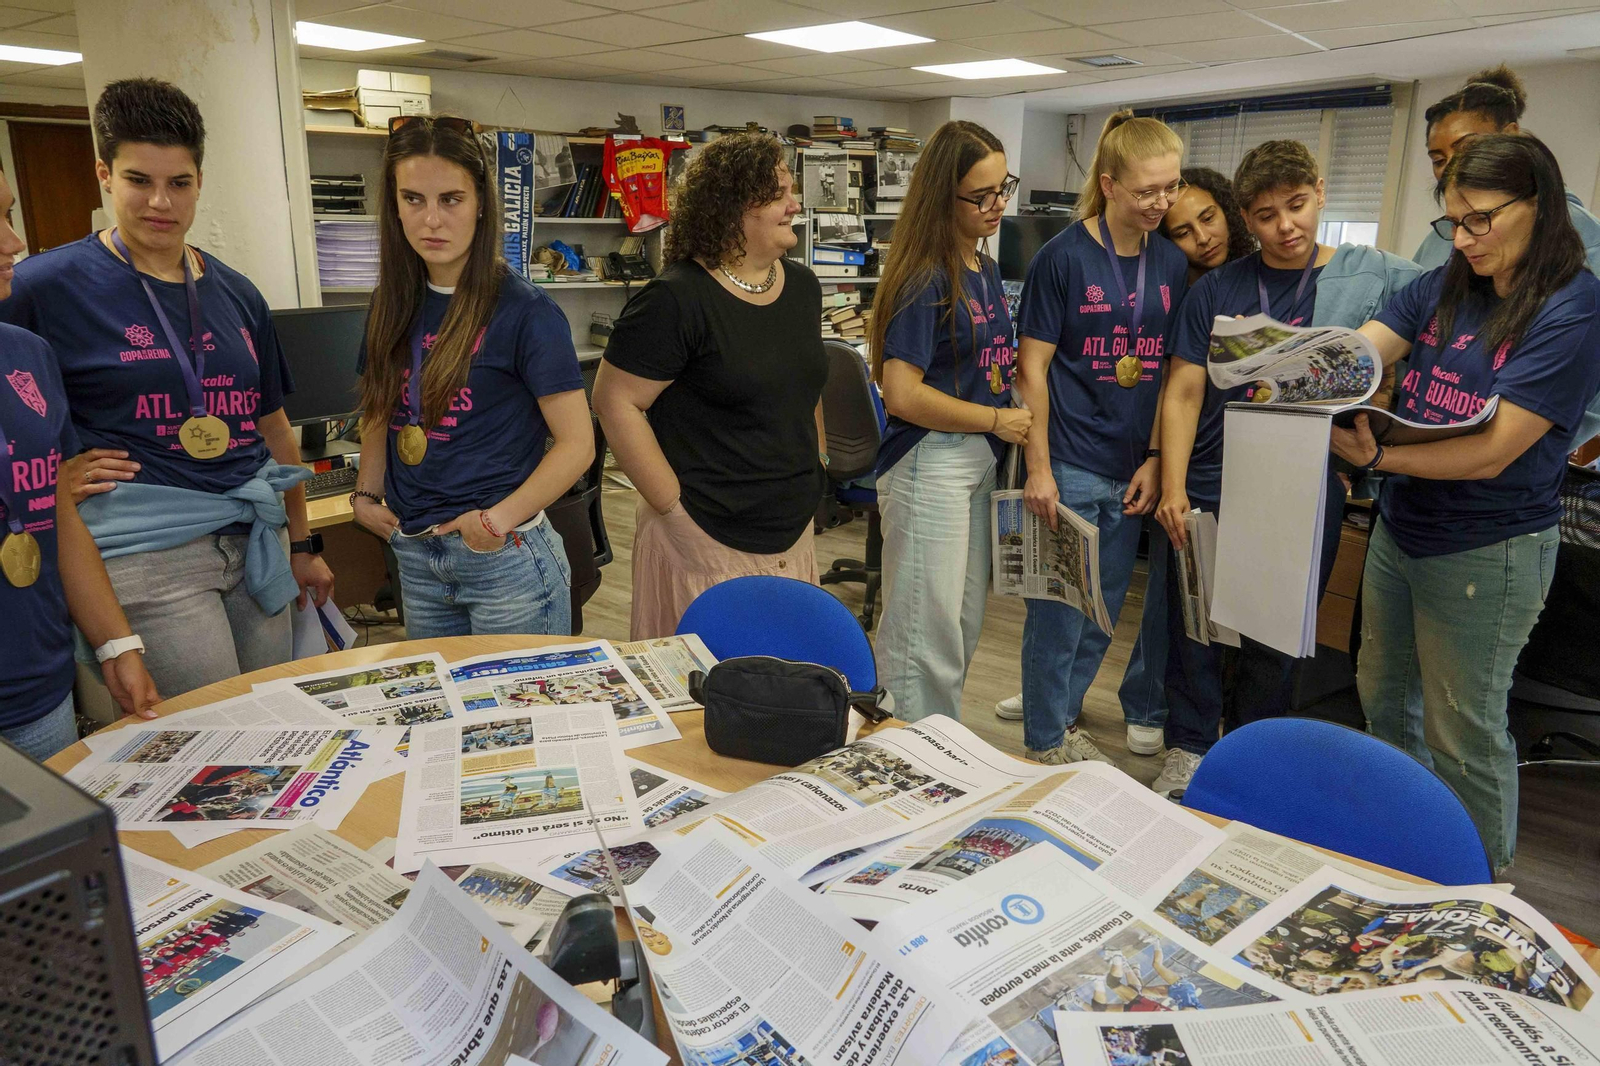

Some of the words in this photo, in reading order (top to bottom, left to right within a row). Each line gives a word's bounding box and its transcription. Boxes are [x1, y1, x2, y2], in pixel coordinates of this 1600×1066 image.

[1079, 305, 1093, 314] COPA
[1097, 304, 1112, 313] REINA
[120, 351, 142, 362] COPA
[148, 348, 171, 359] REINA
[1082, 337, 1110, 356] ATL.
[1112, 334, 1164, 356] GURDÉ
[135, 393, 183, 419] ATL.
[1425, 380, 1487, 418] GUARDÉS
[618, 720, 656, 735] Atlántic
[921, 732, 946, 752] paso
[299, 738, 371, 808] Atlántico
[652, 789, 681, 808] Guardés
[800, 777, 848, 812] cañonazos
[526, 825, 539, 834] el
[541, 822, 570, 833] será
[572, 820, 583, 830] si
[1209, 861, 1223, 871] su
[1228, 861, 1272, 886] europeo
[743, 871, 760, 887] curso
[748, 876, 766, 893] Lloria
[898, 882, 938, 896] porte
[1224, 868, 1277, 896] conquista
[177, 892, 214, 914] Nada
[719, 884, 747, 911] lesionado
[729, 889, 752, 911] regresa
[135, 910, 176, 937] person
[703, 916, 714, 927] 42
[708, 911, 729, 932] Novás
[710, 907, 722, 919] con
[1118, 909, 1133, 924] El
[690, 923, 706, 938] años
[698, 928, 712, 941] tras
[908, 933, 929, 948] 886
[952, 912, 1010, 948] confía
[1078, 916, 1122, 946] Guardés,
[840, 940, 856, 956] E
[1058, 940, 1082, 959] ante
[1384, 908, 1573, 996] CAMPEONAS
[1021, 958, 1050, 981] meta
[1047, 953, 1061, 966] la
[497, 958, 513, 990] Las
[859, 970, 894, 1021] Madeira
[886, 977, 905, 1000] del
[895, 985, 916, 1009] Las
[978, 974, 1024, 1008] europea
[484, 994, 501, 1026] que
[697, 995, 742, 1024] especiales
[739, 1002, 750, 1013] El
[1457, 988, 1491, 1012] para
[712, 1011, 740, 1031] sector
[862, 998, 892, 1041] Kuban
[892, 995, 927, 1044] DEPORTES
[1316, 1004, 1336, 1025] España
[1330, 1023, 1340, 1032] cae
[1336, 1032, 1351, 1047] ante
[1482, 990, 1501, 1000] El
[1493, 1000, 1543, 1045] Guardés,
[1539, 1042, 1555, 1056] a
[1549, 1051, 1575, 1066] Si
[832, 1020, 865, 1062] avisan
[855, 1040, 866, 1051] y
[1317, 1026, 1339, 1048] puestos
[844, 1050, 861, 1066] de
